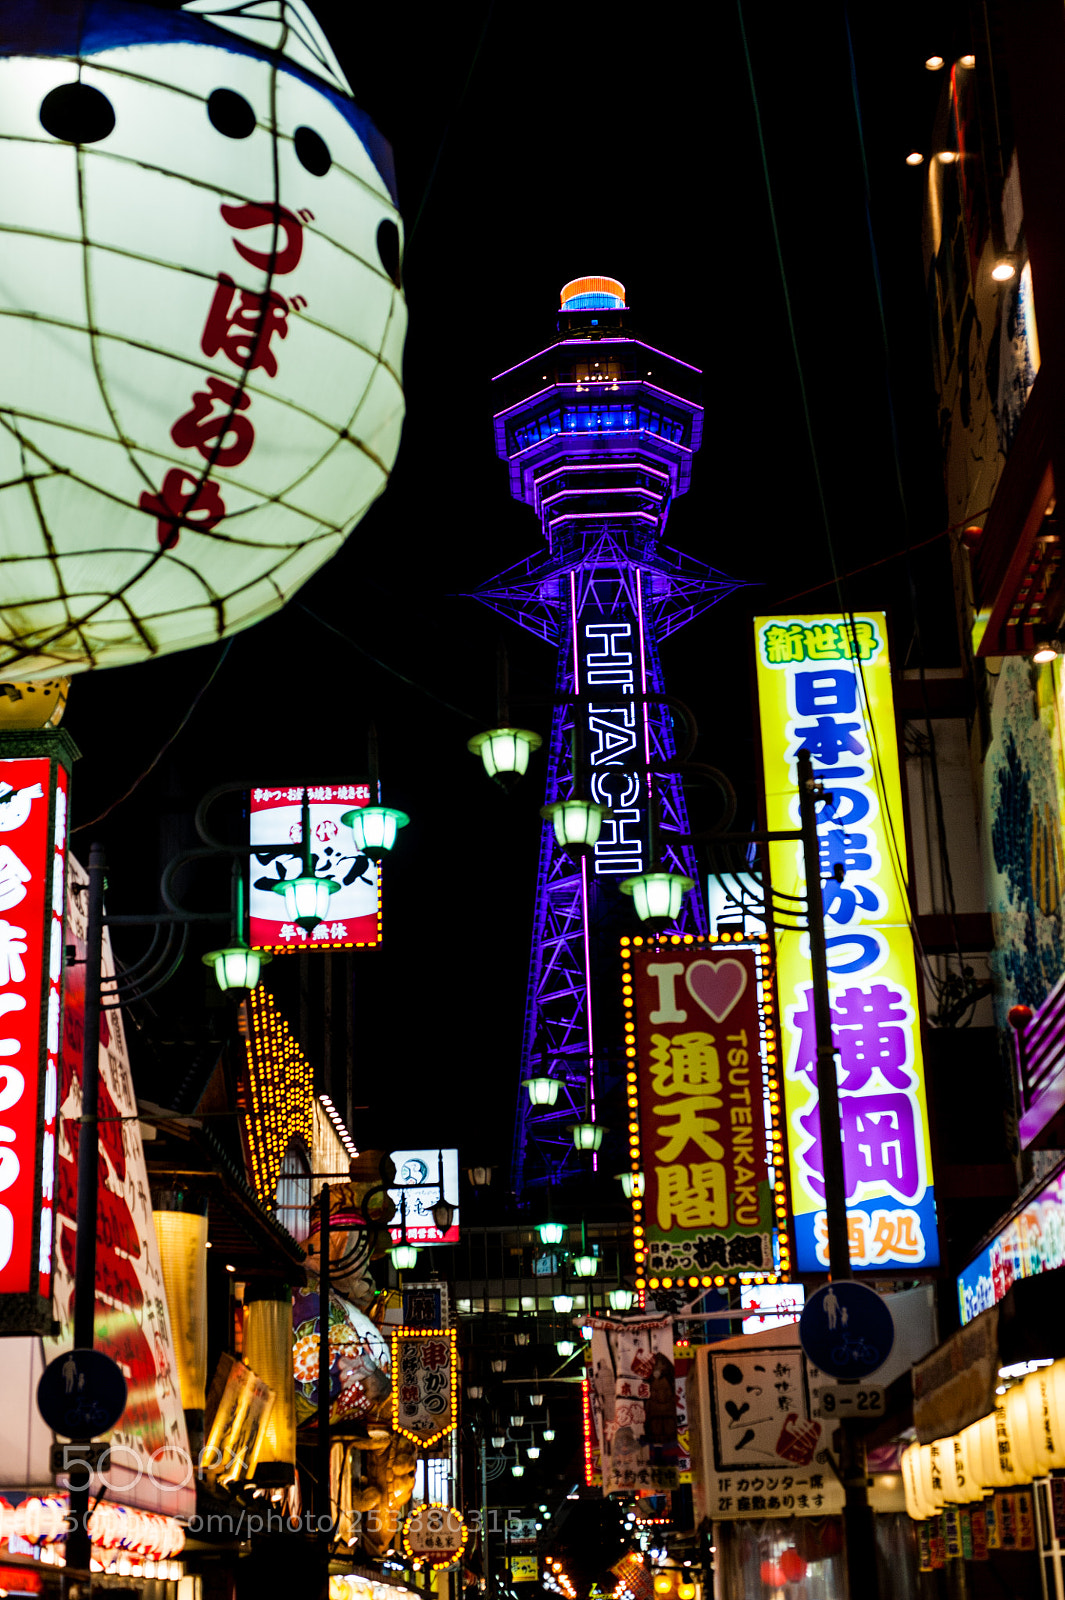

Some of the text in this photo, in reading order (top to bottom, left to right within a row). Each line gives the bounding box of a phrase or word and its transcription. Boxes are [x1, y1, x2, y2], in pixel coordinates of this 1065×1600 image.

[138, 202, 316, 549] づぼらや
[764, 621, 880, 662] 新世界
[586, 623, 642, 874] HITACHI
[647, 962, 687, 1024] I
[649, 1031, 729, 1230] 通天閣
[726, 1029, 760, 1226] TSUTENKAKU
[651, 1256, 692, 1271] 串かつ
[421, 1341, 449, 1416] 串かつ
[718, 1474, 824, 1493] 1F カウンター席
[718, 1494, 825, 1512] 2F 座敷あります
